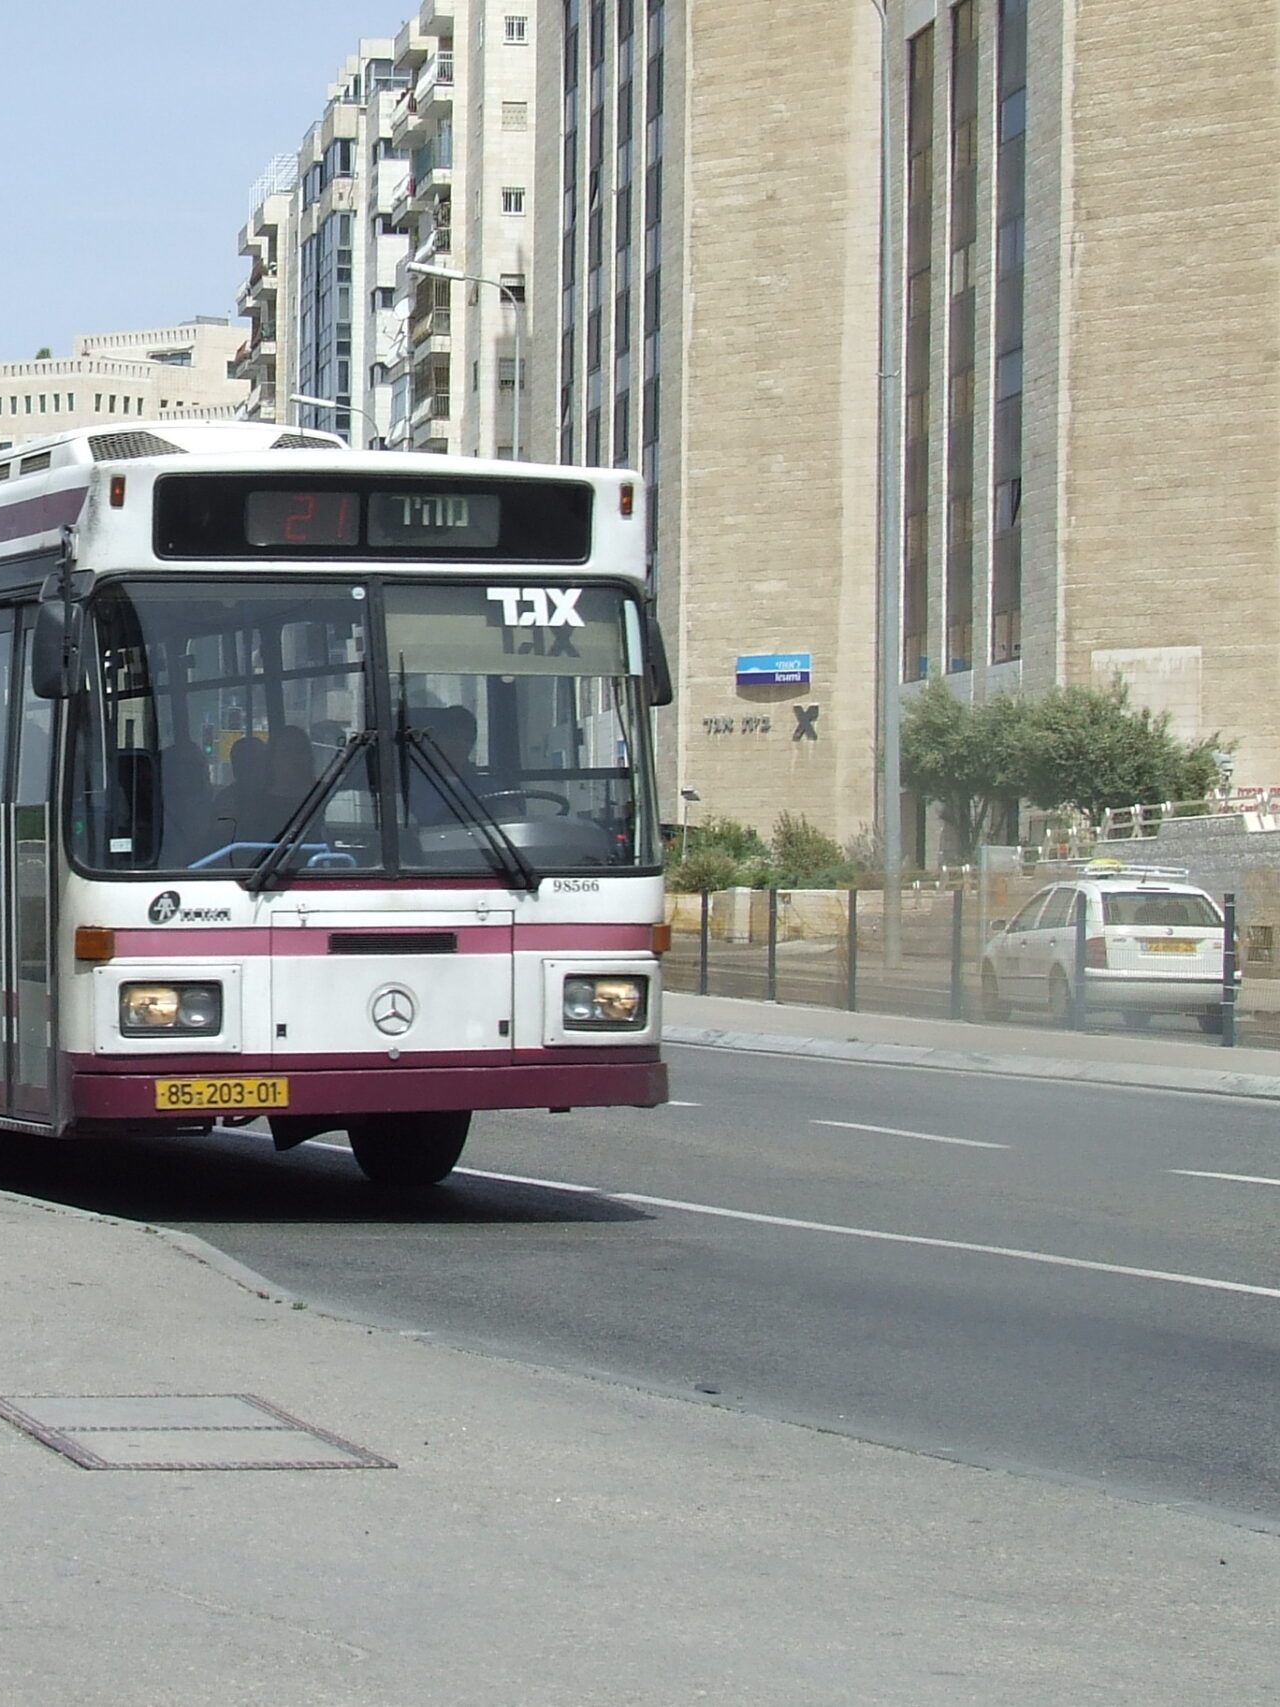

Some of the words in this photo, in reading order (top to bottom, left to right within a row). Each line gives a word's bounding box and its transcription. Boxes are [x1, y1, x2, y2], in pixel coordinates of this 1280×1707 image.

[285, 495, 350, 541] 21
[391, 496, 470, 527] מהיר
[486, 587, 586, 627] אגד
[553, 879, 600, 893] 98566
[167, 1082, 278, 1105] 85-203-01
